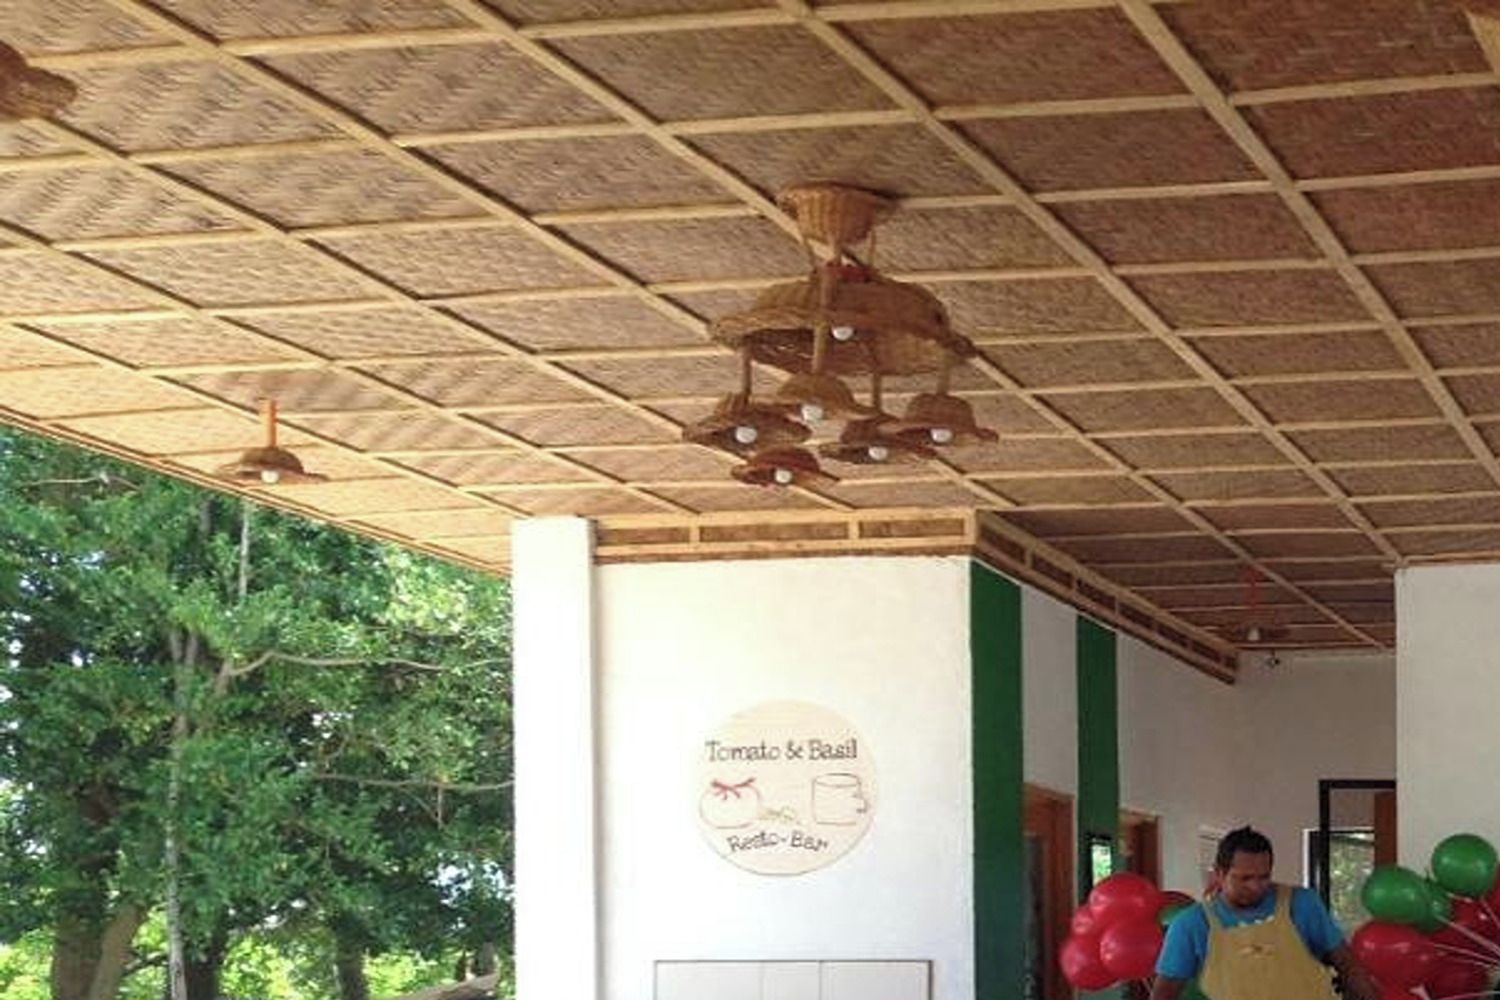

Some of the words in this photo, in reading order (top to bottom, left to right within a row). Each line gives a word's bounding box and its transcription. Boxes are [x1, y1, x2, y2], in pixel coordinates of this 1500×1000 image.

[705, 738, 780, 762] Tomato
[784, 741, 804, 760] &
[808, 737, 858, 761] Basil
